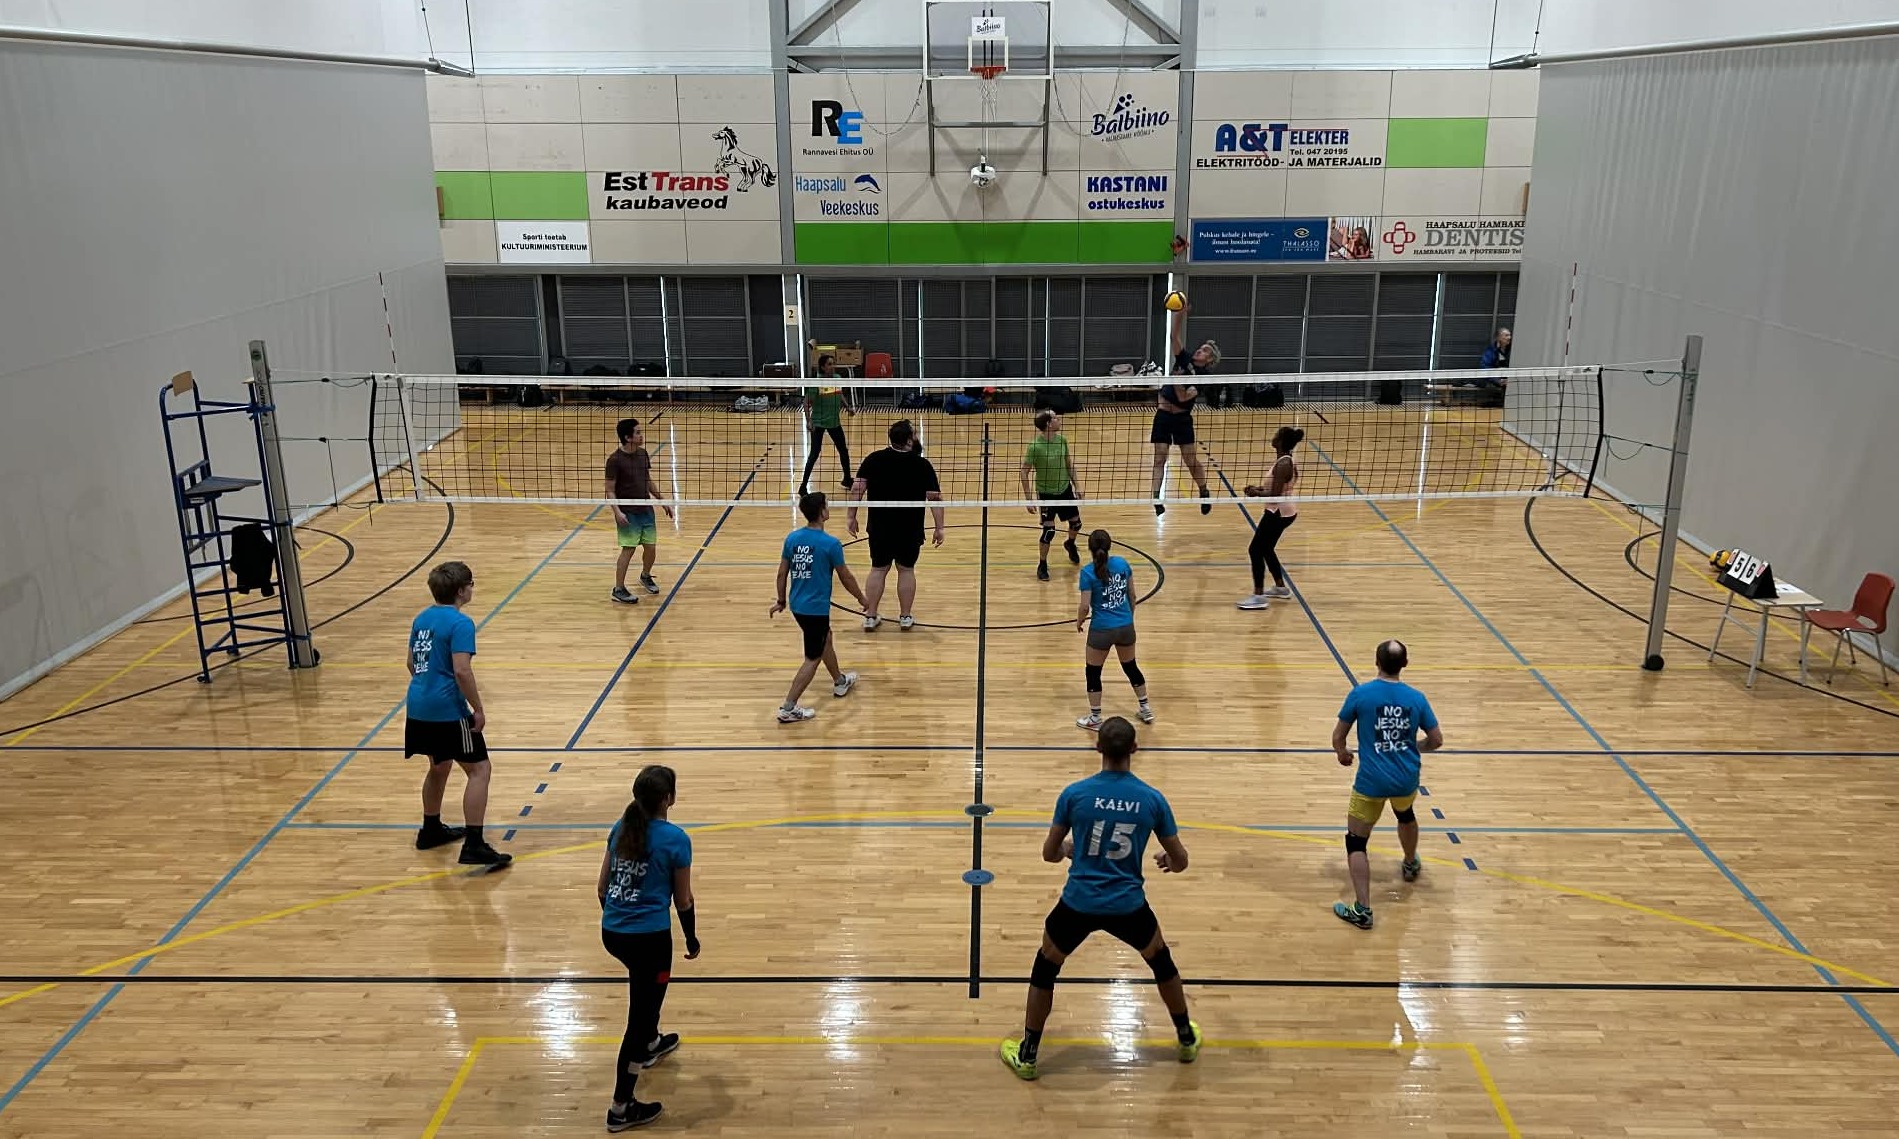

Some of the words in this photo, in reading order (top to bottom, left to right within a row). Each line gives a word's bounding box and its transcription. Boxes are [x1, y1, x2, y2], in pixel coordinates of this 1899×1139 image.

[1091, 107, 1170, 135] Balbiino
[1215, 123, 1289, 152] A&T
[1290, 130, 1349, 145] ELEKTER
[802, 148, 837, 156] Rannavesi
[839, 148, 861, 156] Ehitus
[862, 147, 874, 156] OÜ
[1323, 148, 1348, 156] 20195
[1288, 157, 1303, 167] JA
[1307, 157, 1382, 167] MATERJALID
[795, 175, 846, 194] Haapsalu
[1087, 176, 1168, 192] KASTANI
[606, 195, 728, 210] kaubaveod
[820, 199, 879, 216] Veekeskus
[1088, 197, 1165, 210] ostukeskus
[1425, 221, 1478, 229] HAAPSALU
[522, 233, 543, 241] Sporti
[545, 233, 566, 241] toetab
[1425, 229, 1525, 246] DENTIS
[501, 243, 587, 251] KULTUURIMINISTEERIUM
[788, 309, 794, 318] 2
[798, 545, 809, 554] NO
[792, 554, 813, 563] JESUS
[1734, 557, 1745, 572] 5
[1746, 563, 1756, 578] 6
[792, 570, 812, 579] EACE
[1102, 579, 1127, 596] JESUS
[1109, 590, 1122, 601] NO
[1383, 706, 1403, 717] NO
[1374, 717, 1411, 730] JESUS
[1382, 730, 1400, 740] NO
[1374, 740, 1409, 754] PEACE
[1093, 797, 1141, 813] KALVI
[1087, 820, 1138, 860] 15
[611, 857, 648, 877] JESUS
[616, 873, 632, 886] NO
[608, 883, 641, 902] PEACE
